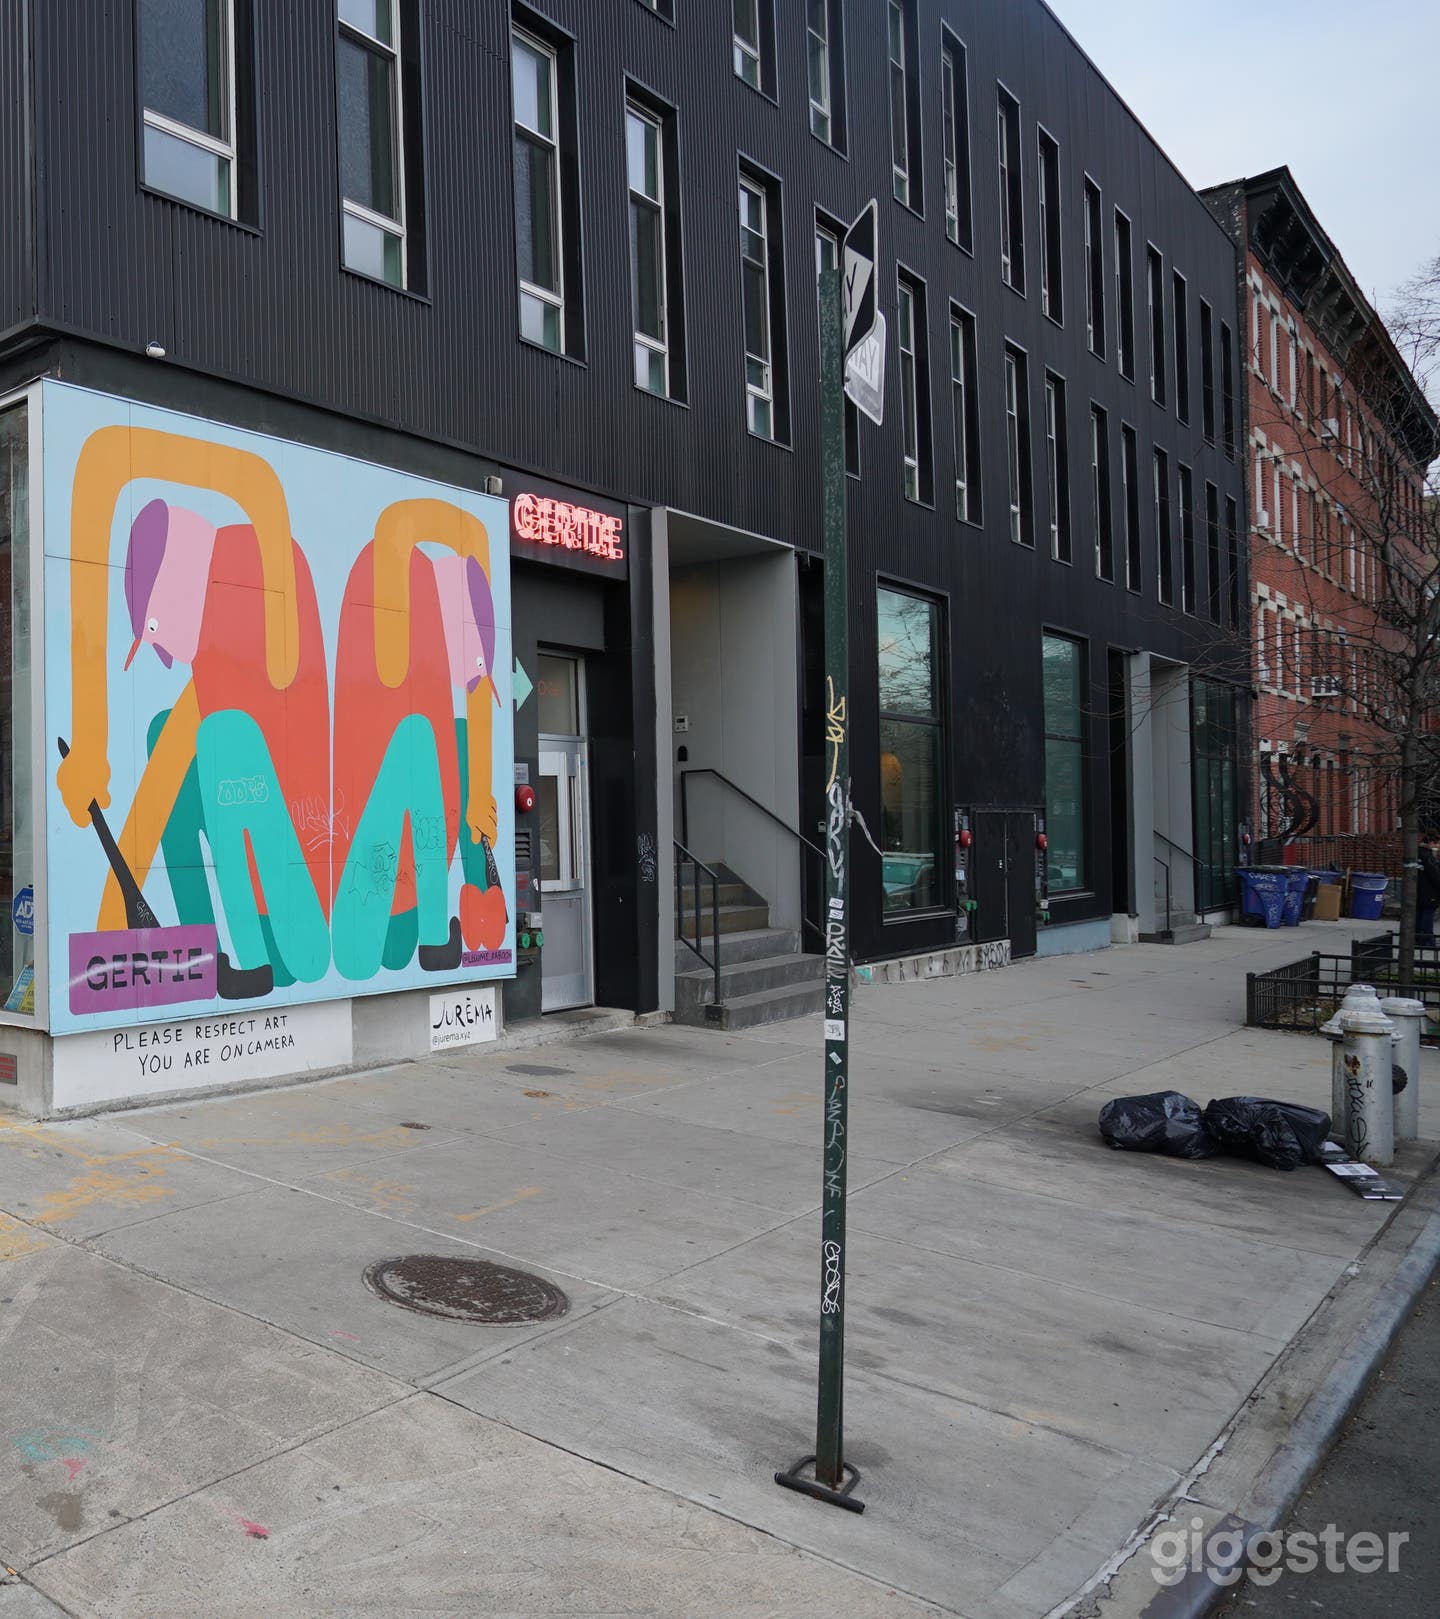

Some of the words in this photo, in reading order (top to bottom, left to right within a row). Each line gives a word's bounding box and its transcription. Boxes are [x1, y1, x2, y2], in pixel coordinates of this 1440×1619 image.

[514, 493, 623, 560] GERTIE
[86, 948, 203, 991] GERTIE
[113, 1029, 183, 1052] PLEASE
[195, 1020, 256, 1039] RESPECT
[264, 1016, 288, 1031] ART
[138, 1054, 172, 1076] YOU
[184, 1048, 210, 1068] ARE
[220, 1044, 243, 1062] ON
[247, 1034, 295, 1055] CAMERA
